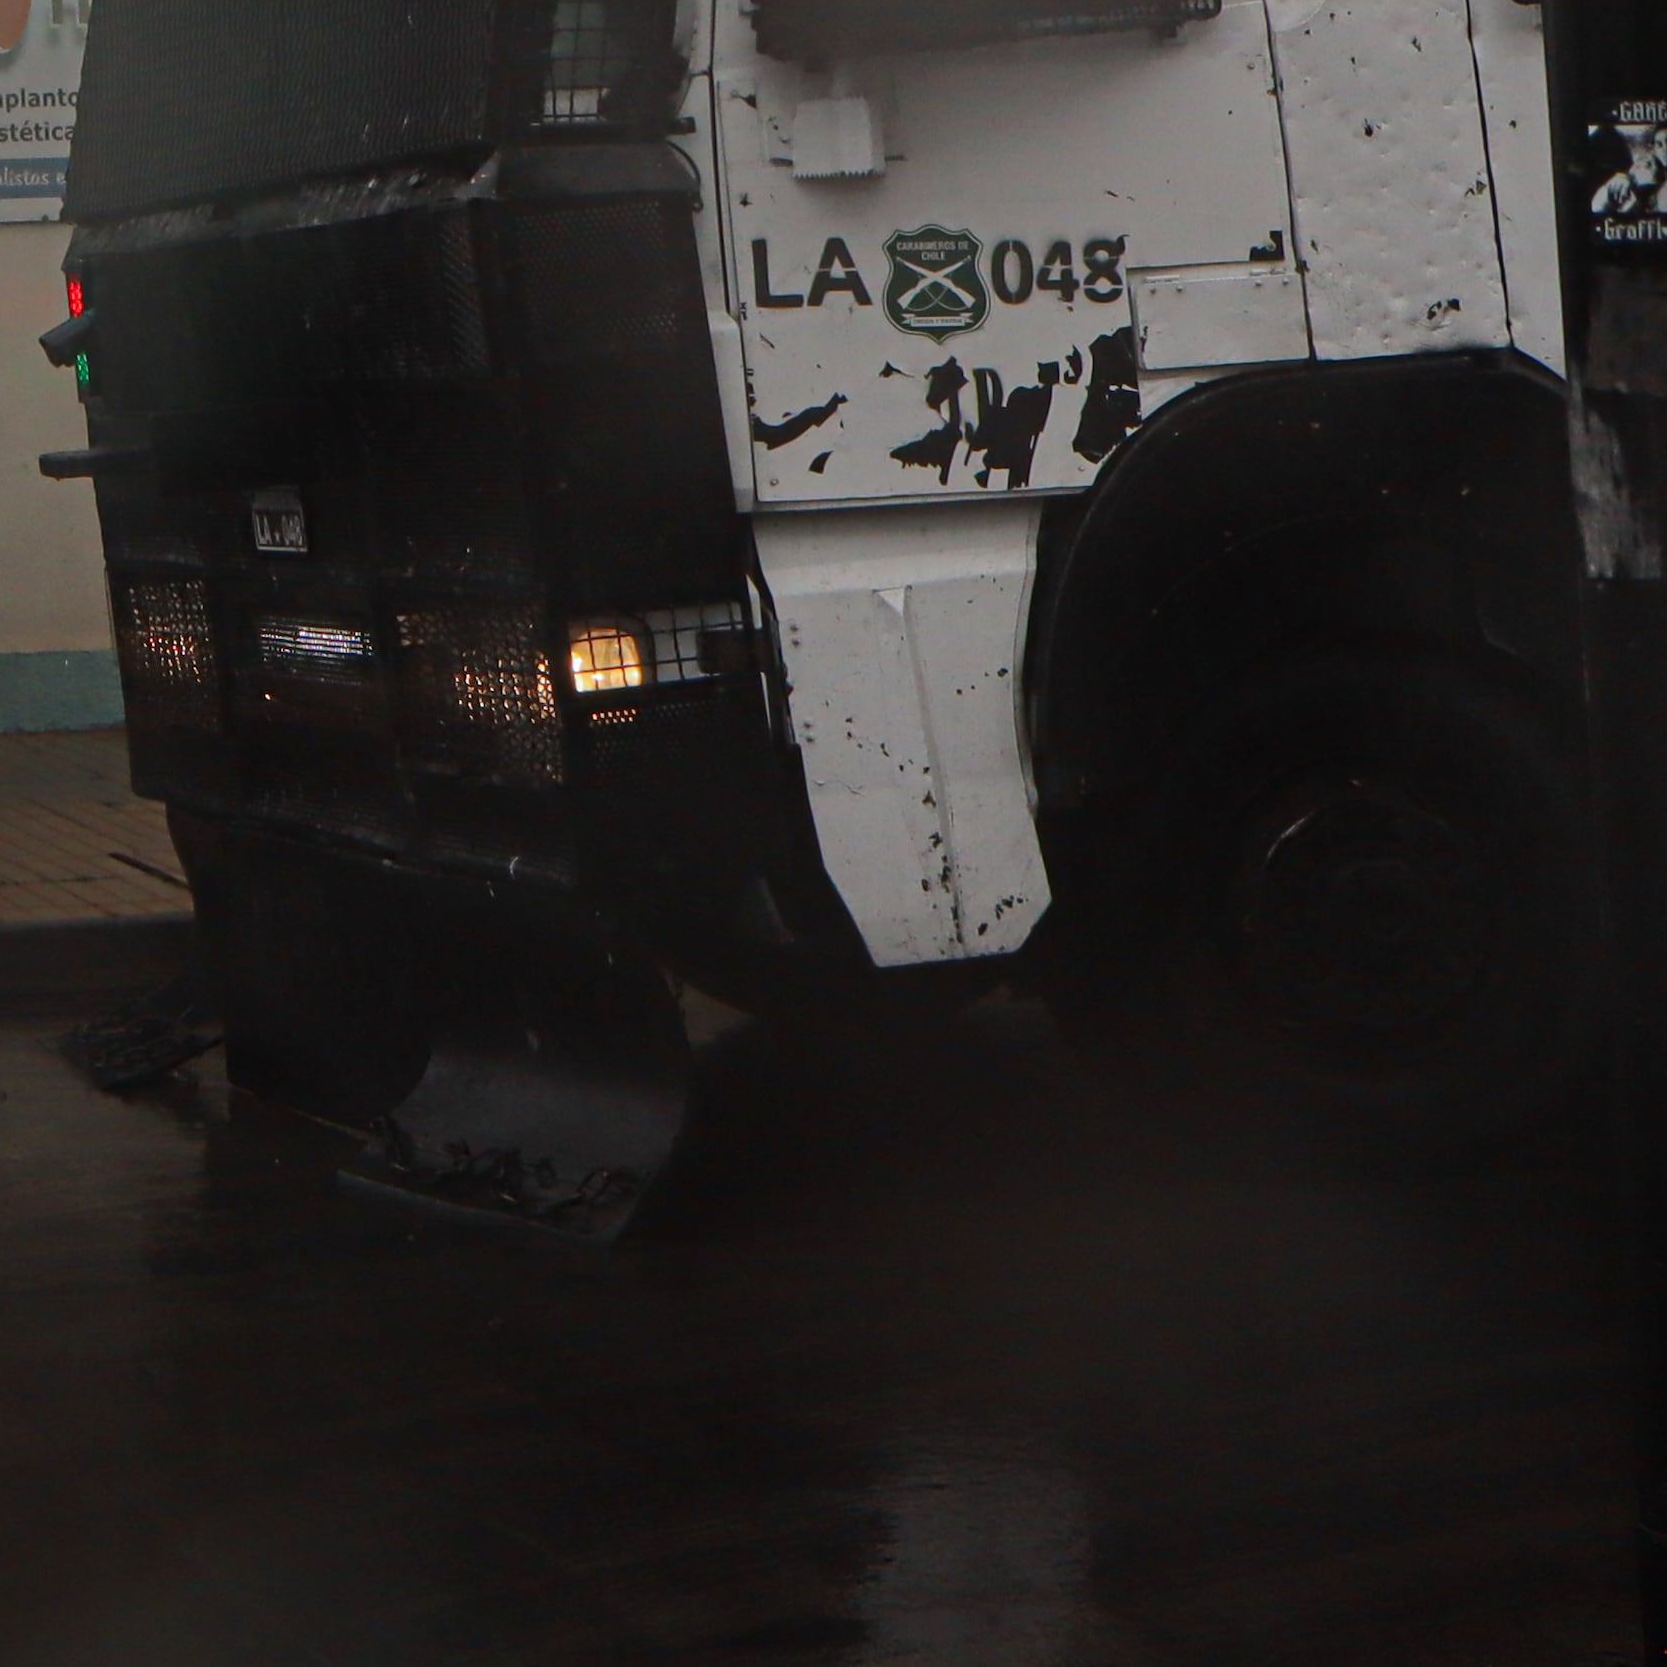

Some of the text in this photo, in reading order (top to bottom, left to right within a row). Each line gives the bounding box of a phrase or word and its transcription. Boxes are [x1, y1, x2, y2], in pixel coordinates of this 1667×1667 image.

[896, 241, 956, 251] CARABINEROS
[921, 251, 946, 261] CHILE
[751, 237, 1127, 308] LA 048
